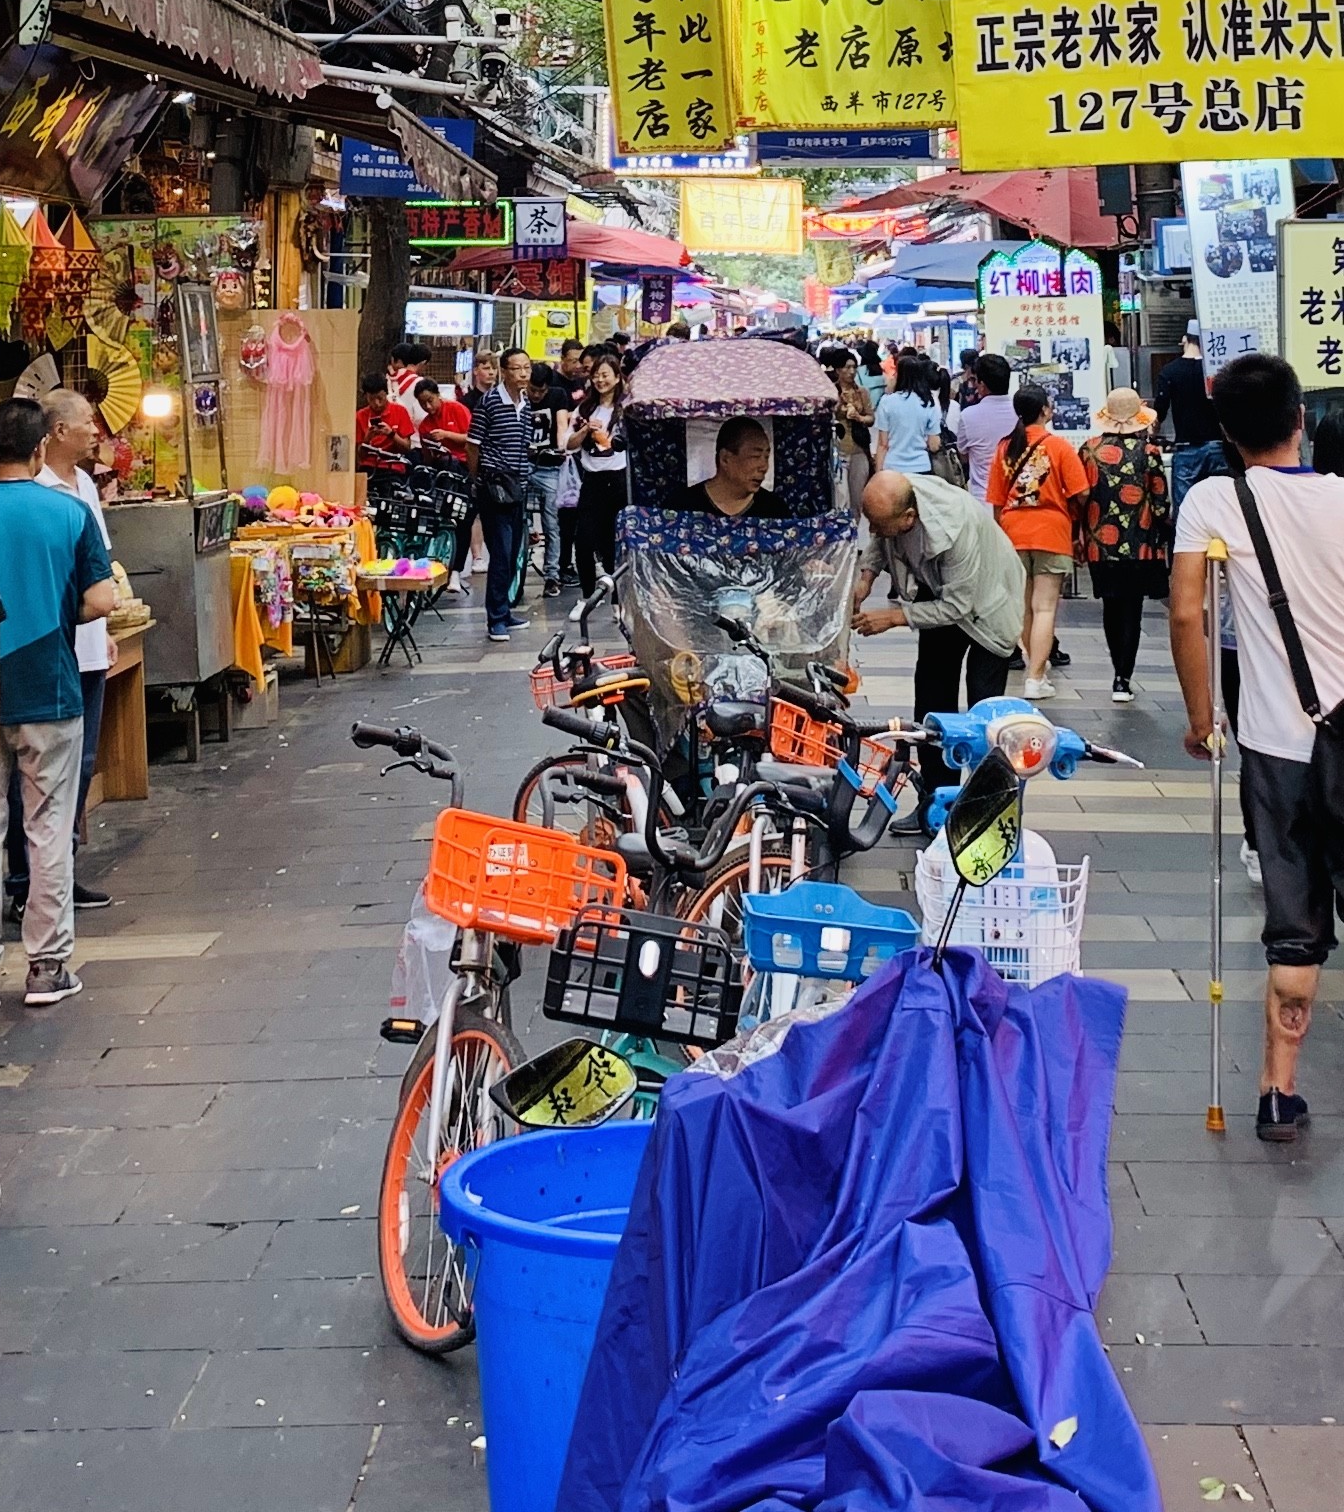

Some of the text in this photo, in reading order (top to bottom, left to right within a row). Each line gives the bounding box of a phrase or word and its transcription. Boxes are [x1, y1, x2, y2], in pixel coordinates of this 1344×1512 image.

[975, 0, 1162, 73] 正宗老米家
[819, 89, 948, 113] 西羊市127号
[1047, 76, 1305, 134] 127号总店
[524, 205, 557, 234] 茶
